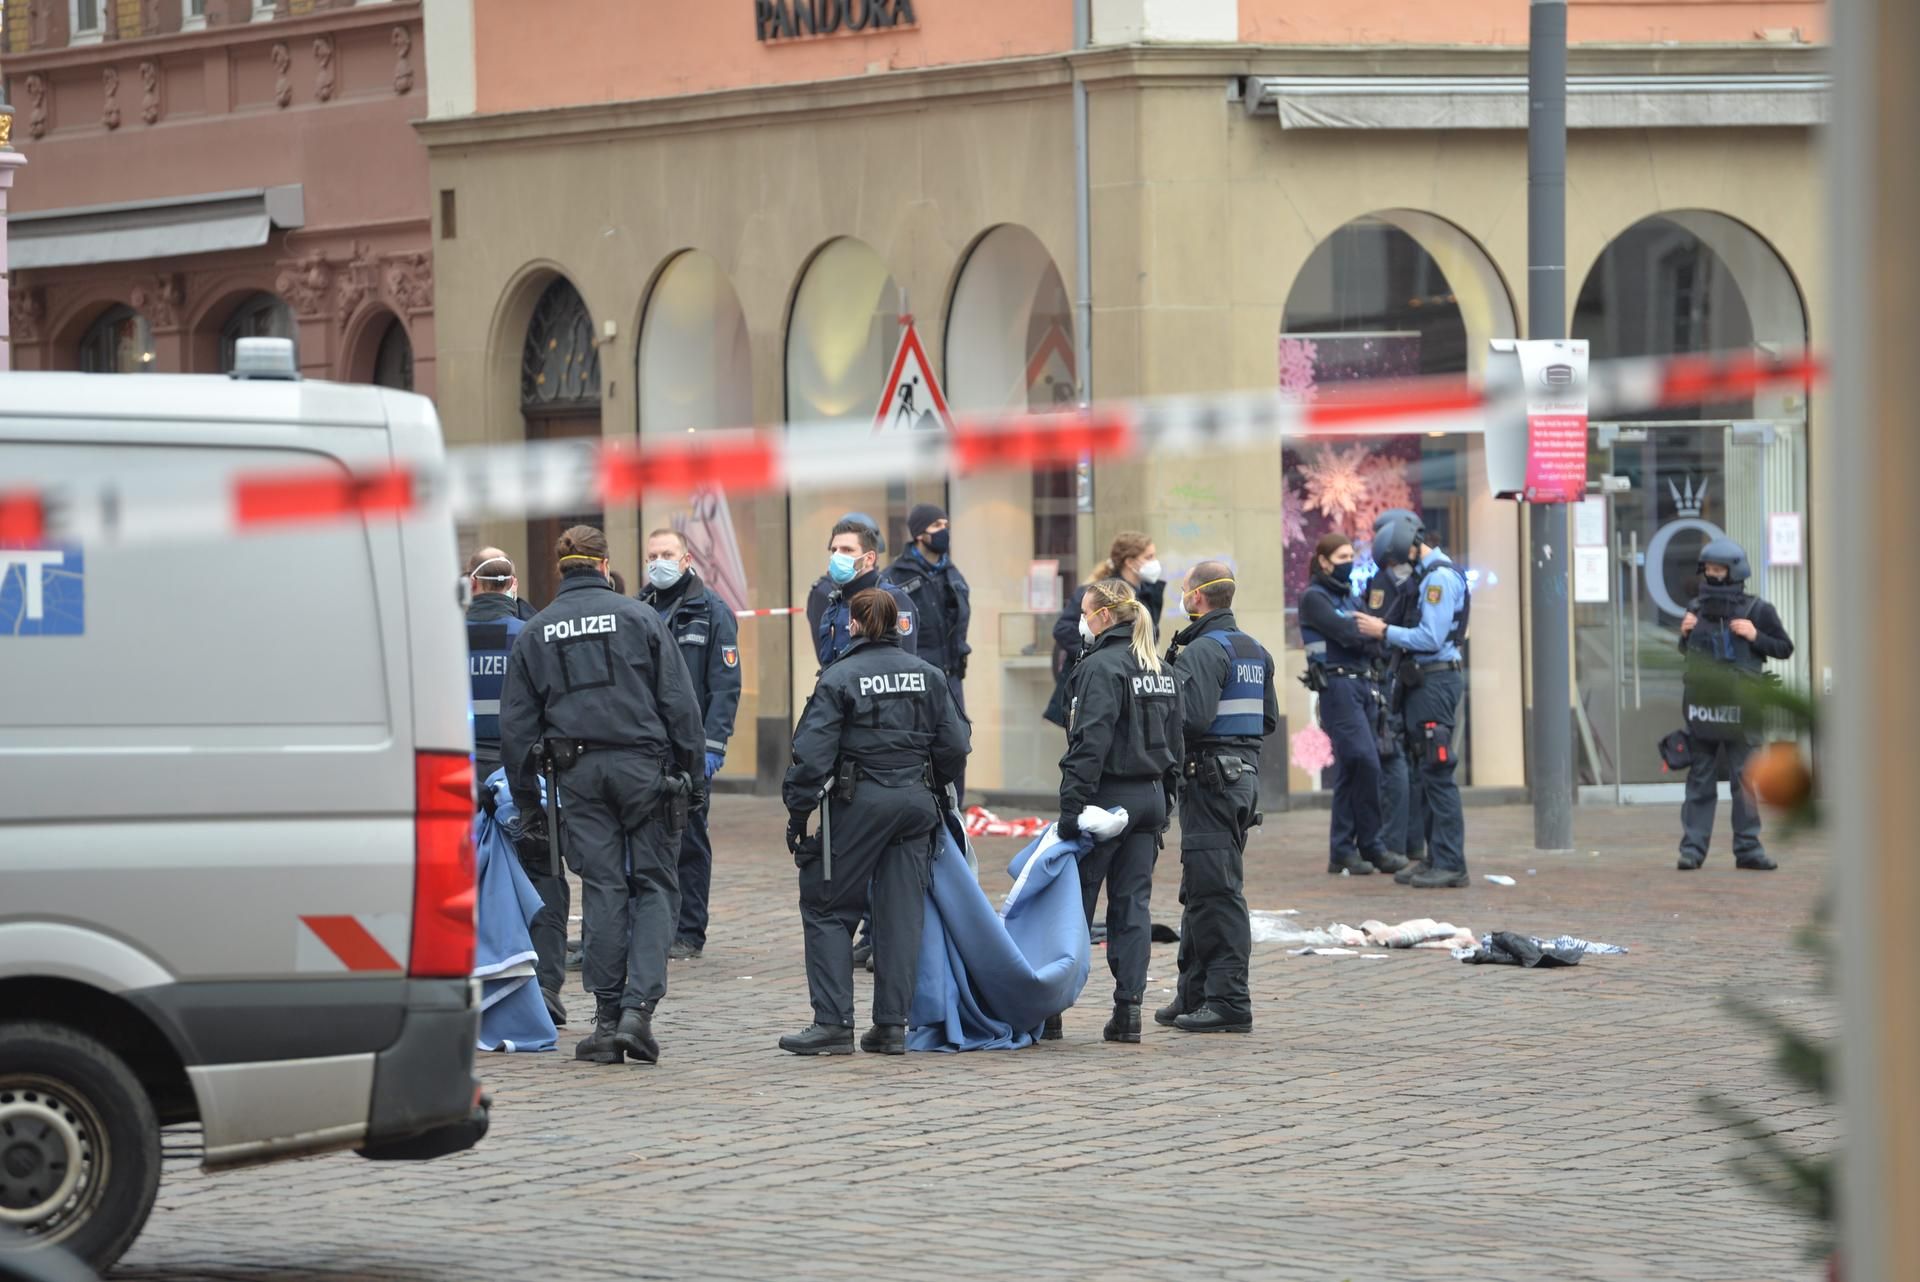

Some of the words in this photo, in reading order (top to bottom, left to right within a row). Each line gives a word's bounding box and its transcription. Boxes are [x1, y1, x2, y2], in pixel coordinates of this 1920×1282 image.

[755, 0, 916, 41] PANDORA
[543, 614, 617, 643] POLIZEI
[471, 655, 507, 676] LIZEI
[1237, 664, 1264, 685] POLIZEI
[859, 673, 926, 696] POLIZEI
[1132, 675, 1176, 695] POLIZEI
[1688, 703, 1741, 724] POLIZEI
